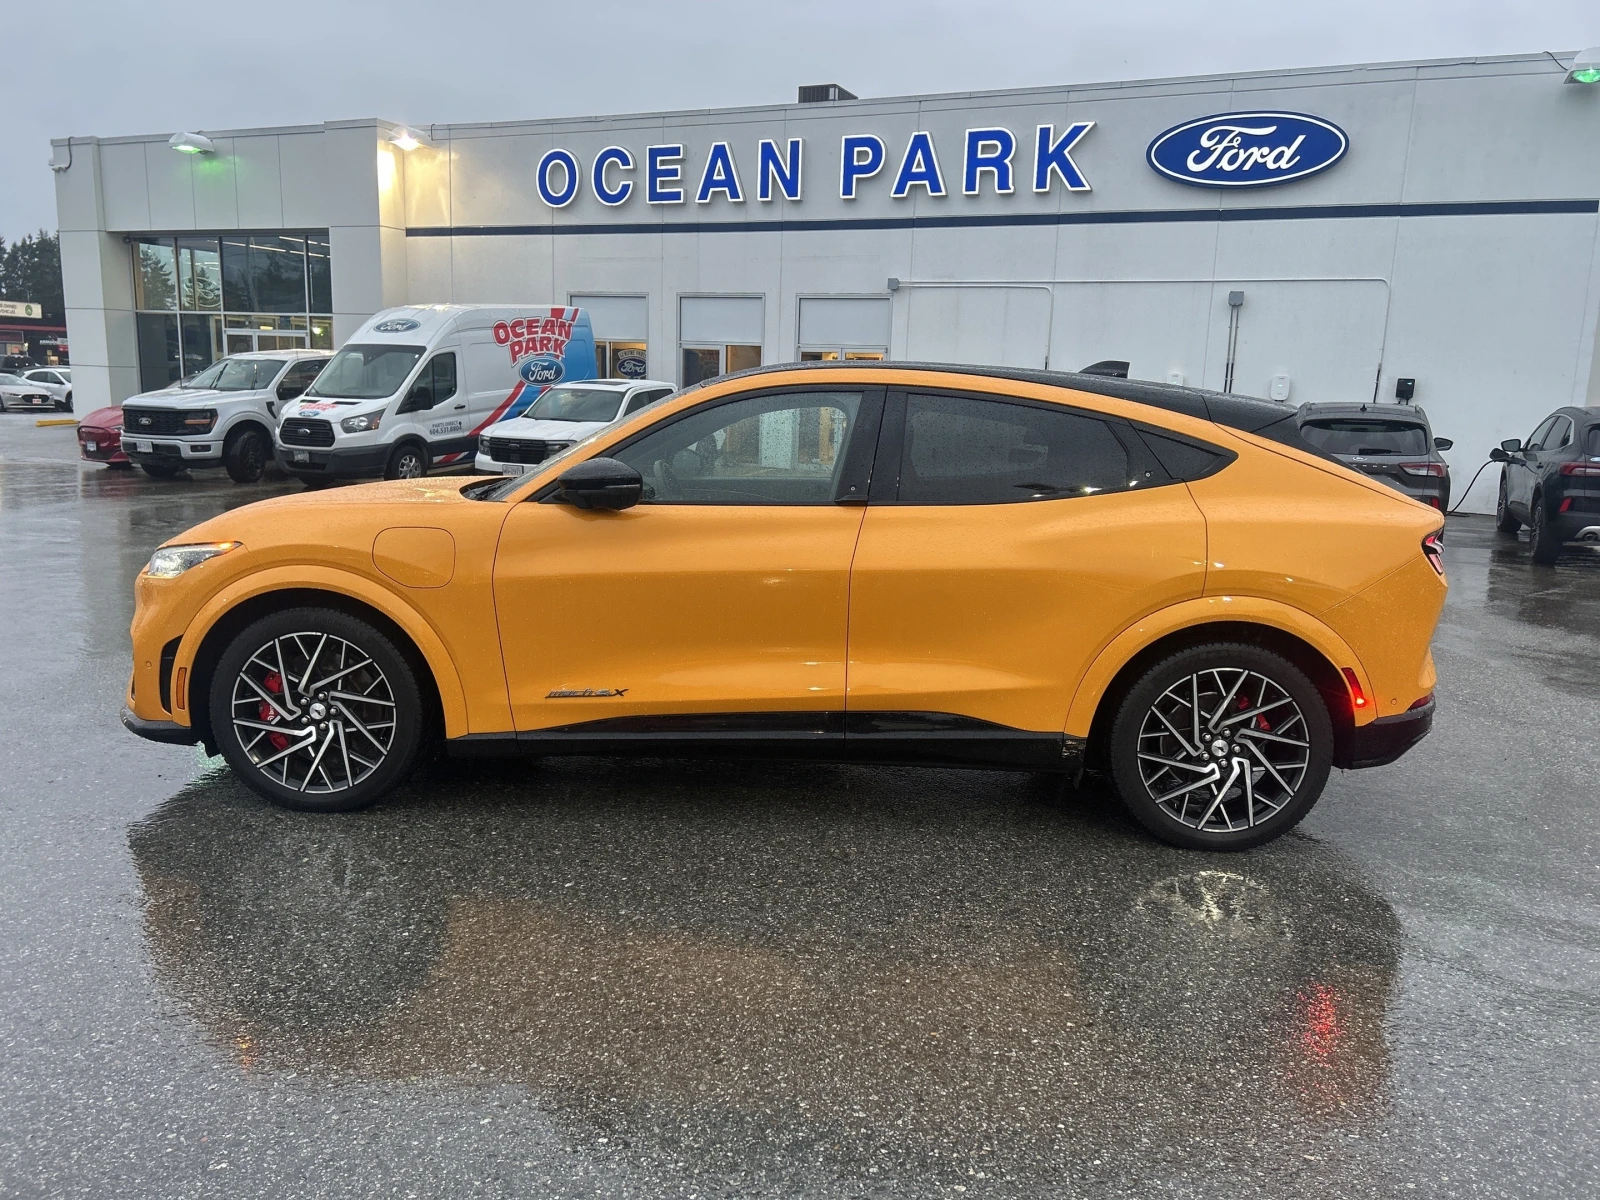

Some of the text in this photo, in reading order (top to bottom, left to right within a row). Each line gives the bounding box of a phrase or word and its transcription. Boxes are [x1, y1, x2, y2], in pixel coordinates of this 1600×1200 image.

[536, 121, 1096, 208] OCEAN PARK
[1186, 125, 1307, 173] Ford
[493, 316, 573, 347] OCEAN
[508, 335, 570, 368] PARK
[620, 360, 646, 373] Ford
[528, 360, 556, 381] Ford
